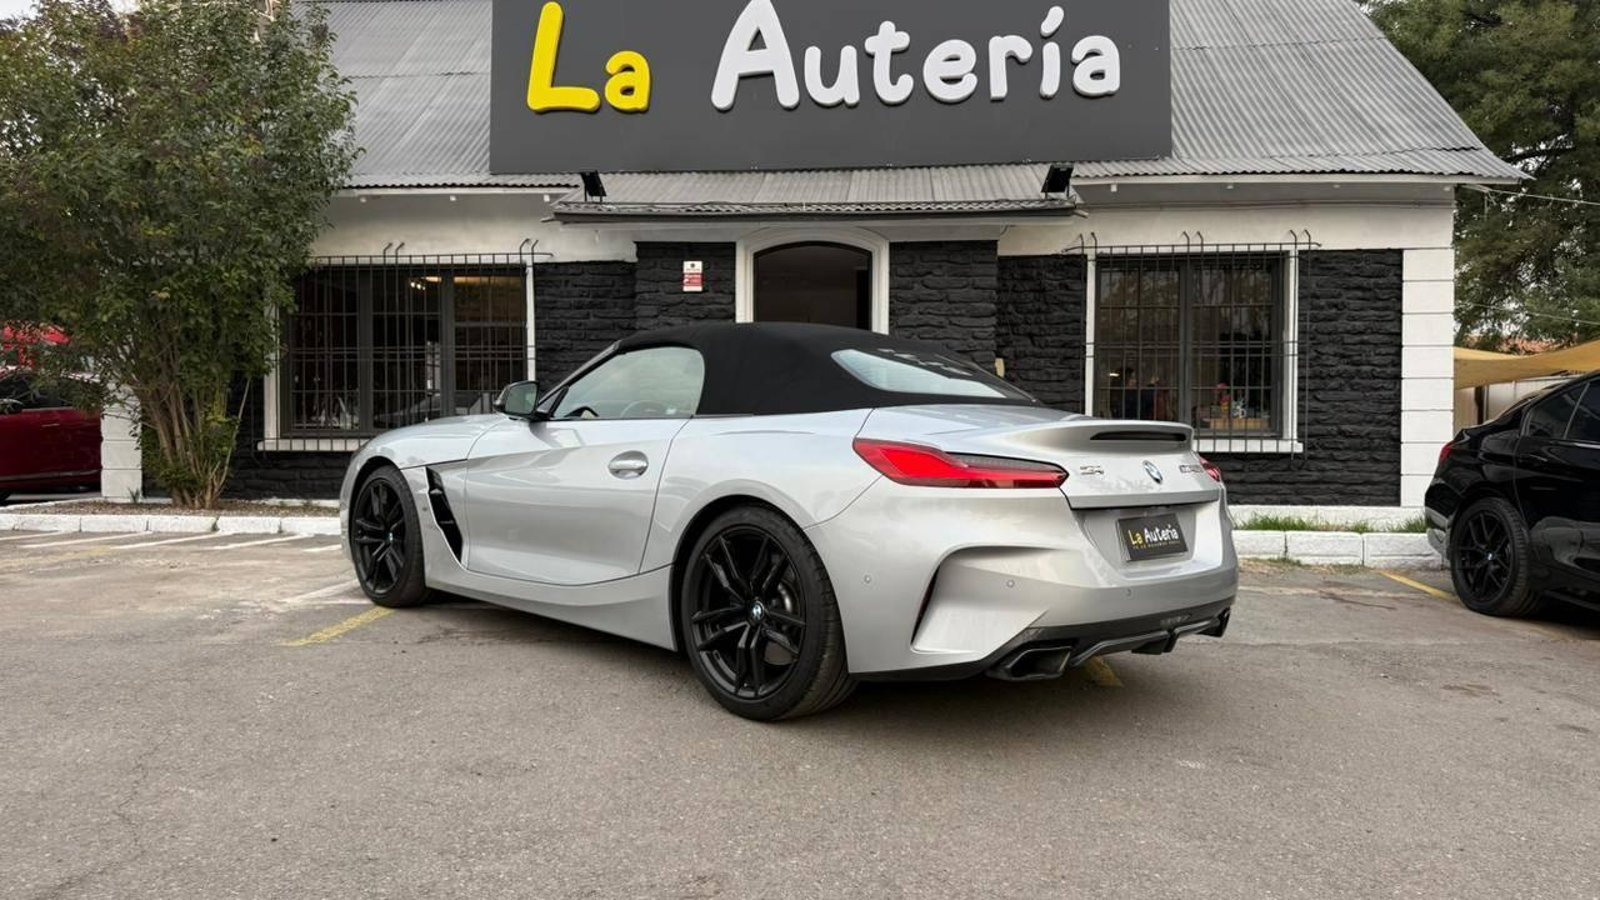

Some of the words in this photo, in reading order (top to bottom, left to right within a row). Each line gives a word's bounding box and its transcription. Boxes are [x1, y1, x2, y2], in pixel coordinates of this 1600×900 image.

[527, 1, 652, 112] La
[711, 0, 1122, 110] Autería
[1128, 529, 1144, 545] La
